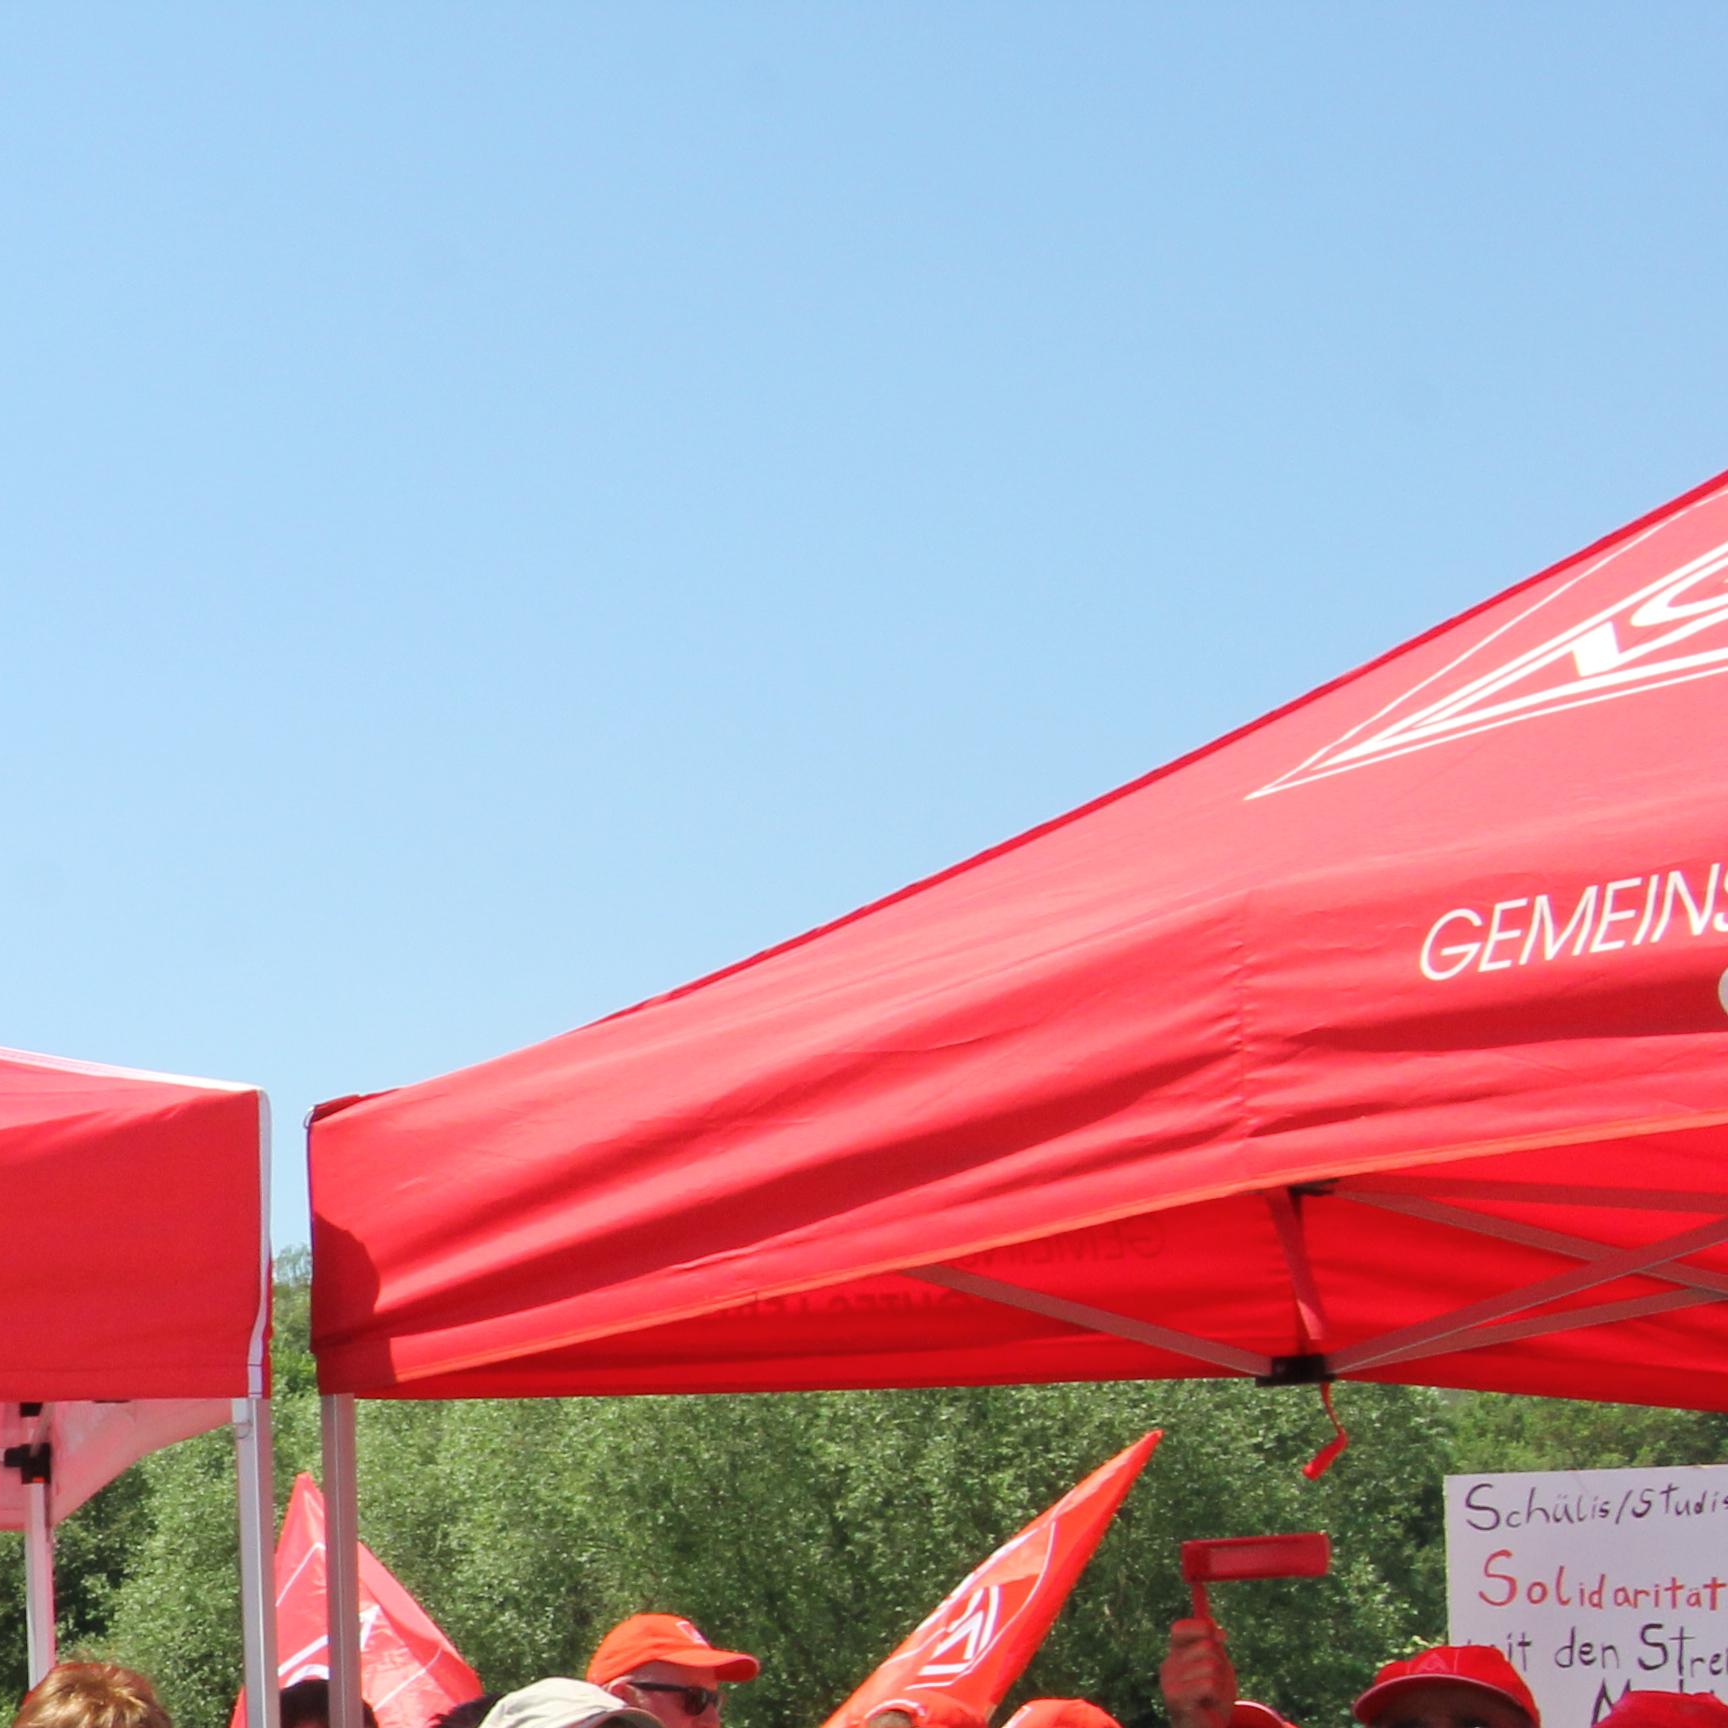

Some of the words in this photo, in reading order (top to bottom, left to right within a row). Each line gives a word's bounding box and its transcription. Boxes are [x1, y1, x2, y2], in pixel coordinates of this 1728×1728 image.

[1478, 1549, 1727, 1611] Solidarität
[1468, 1632, 1532, 1671] it
[1554, 1626, 1620, 1669] den
